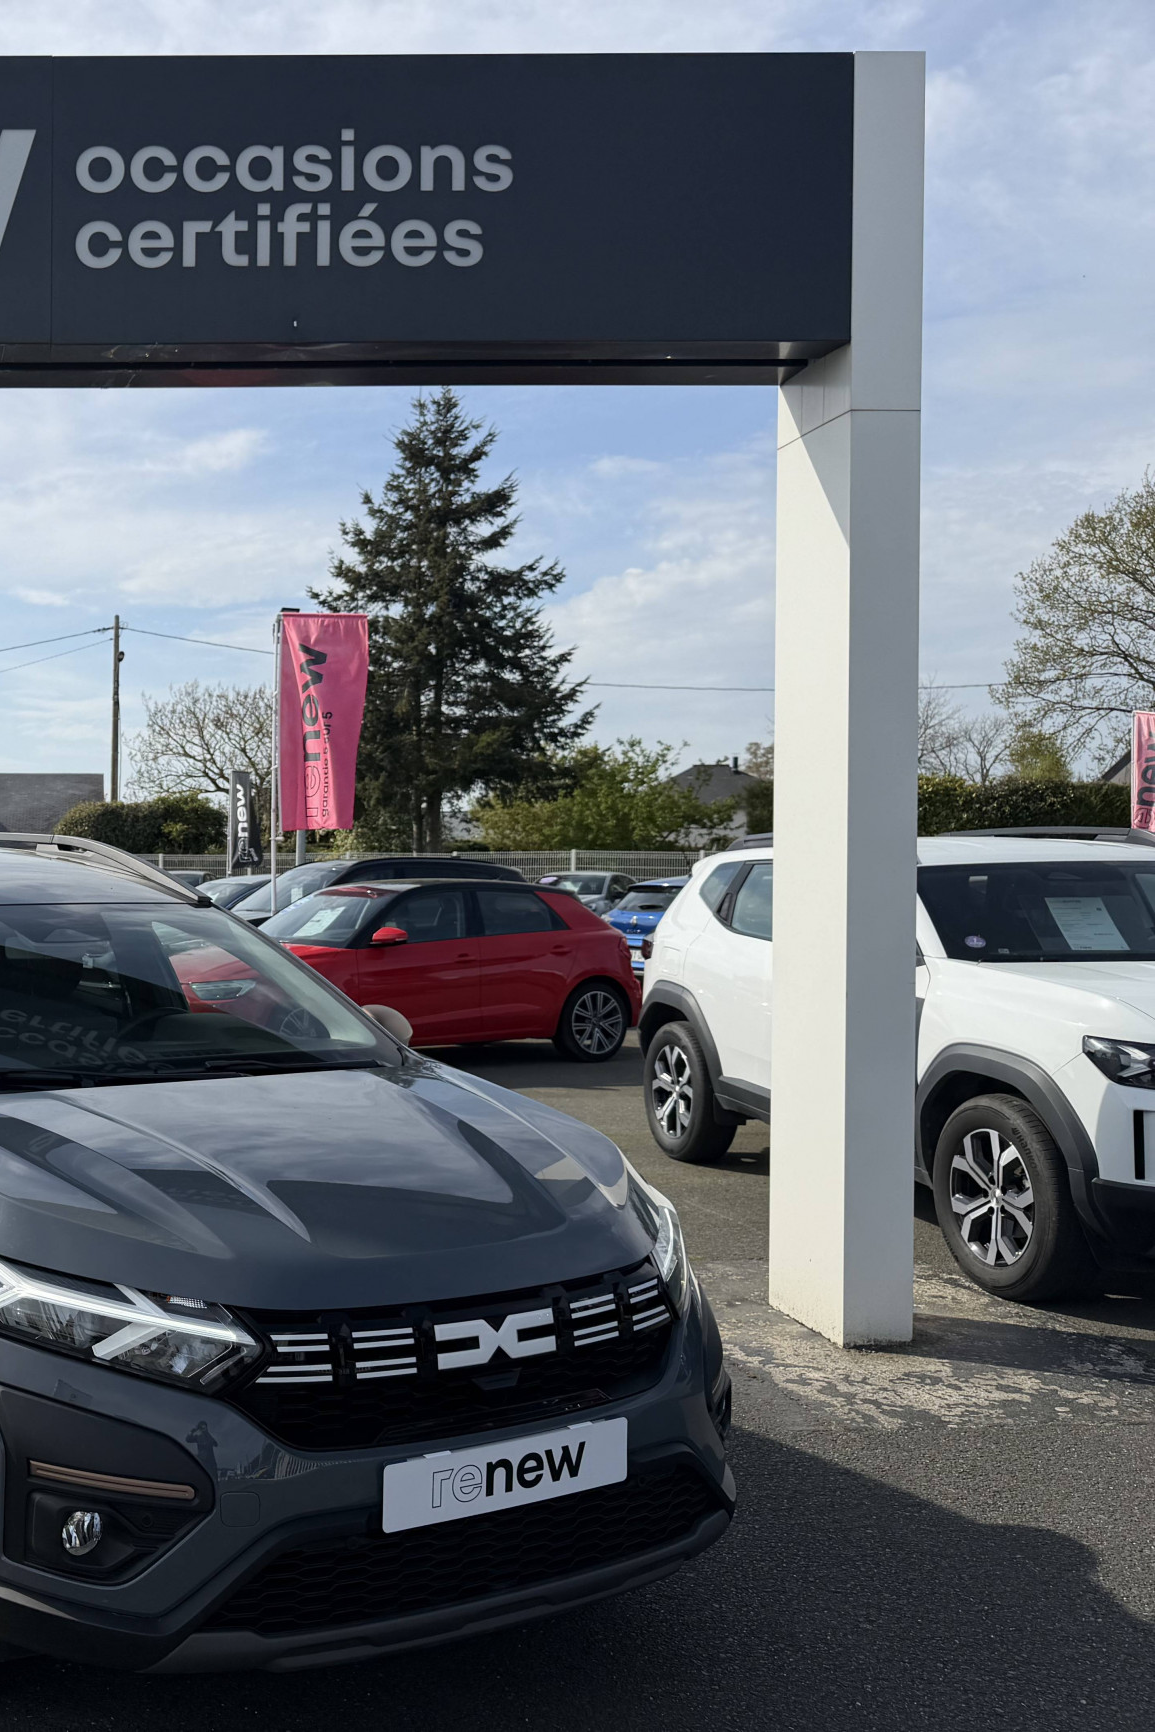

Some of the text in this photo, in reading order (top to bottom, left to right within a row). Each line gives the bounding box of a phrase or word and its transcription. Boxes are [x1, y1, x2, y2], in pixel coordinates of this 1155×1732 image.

[75, 127, 514, 193] occasions
[75, 202, 484, 269] certifiées
[322, 711, 333, 719] 5
[432, 1440, 586, 1509] renew
